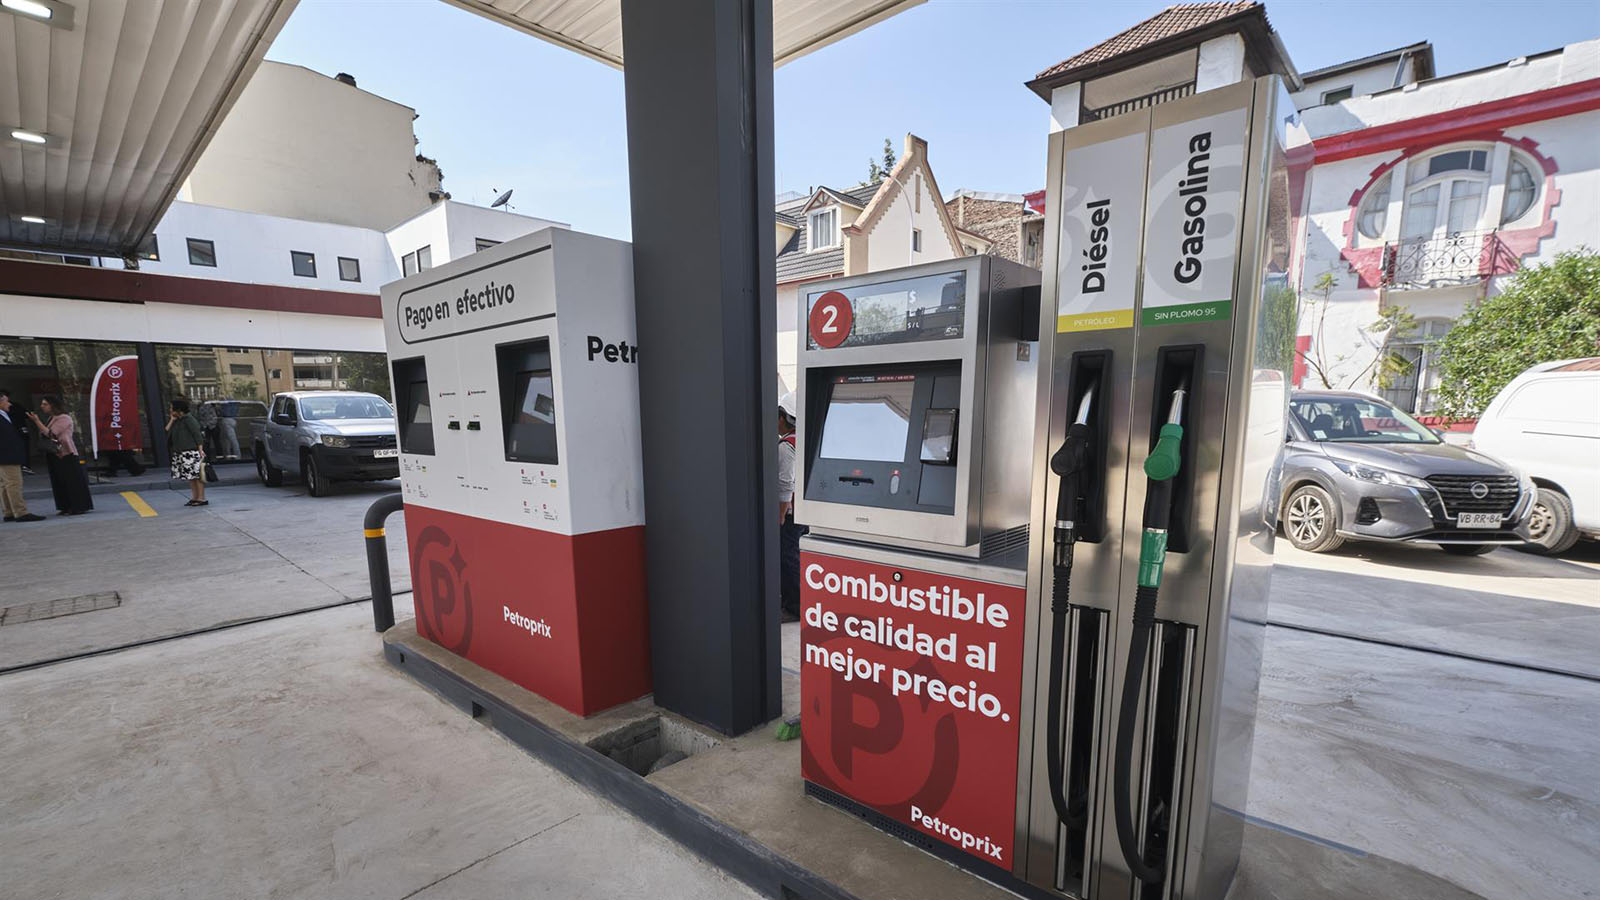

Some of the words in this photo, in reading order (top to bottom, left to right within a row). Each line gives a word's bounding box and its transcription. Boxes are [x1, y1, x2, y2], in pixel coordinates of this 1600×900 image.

[1174, 131, 1212, 284] Gasolina
[1081, 198, 1111, 294] Diésel
[405, 306, 433, 330] Pago
[435, 301, 450, 320] en
[456, 281, 515, 315] efectivo
[821, 305, 839, 334] 2
[909, 289, 917, 304] $
[1154, 311, 1169, 320] SIN
[1170, 308, 1203, 319] PLOMO
[1204, 307, 1216, 316] 95
[109, 382, 122, 429] Petroprix
[503, 605, 552, 639] Petroprix
[804, 562, 1010, 629] Combustible
[805, 602, 838, 633] de
[844, 616, 957, 663] calidad
[966, 641, 996, 673] al
[805, 643, 886, 682] mejor
[892, 667, 1010, 723] precio.
[911, 804, 1003, 861] Petroprix
